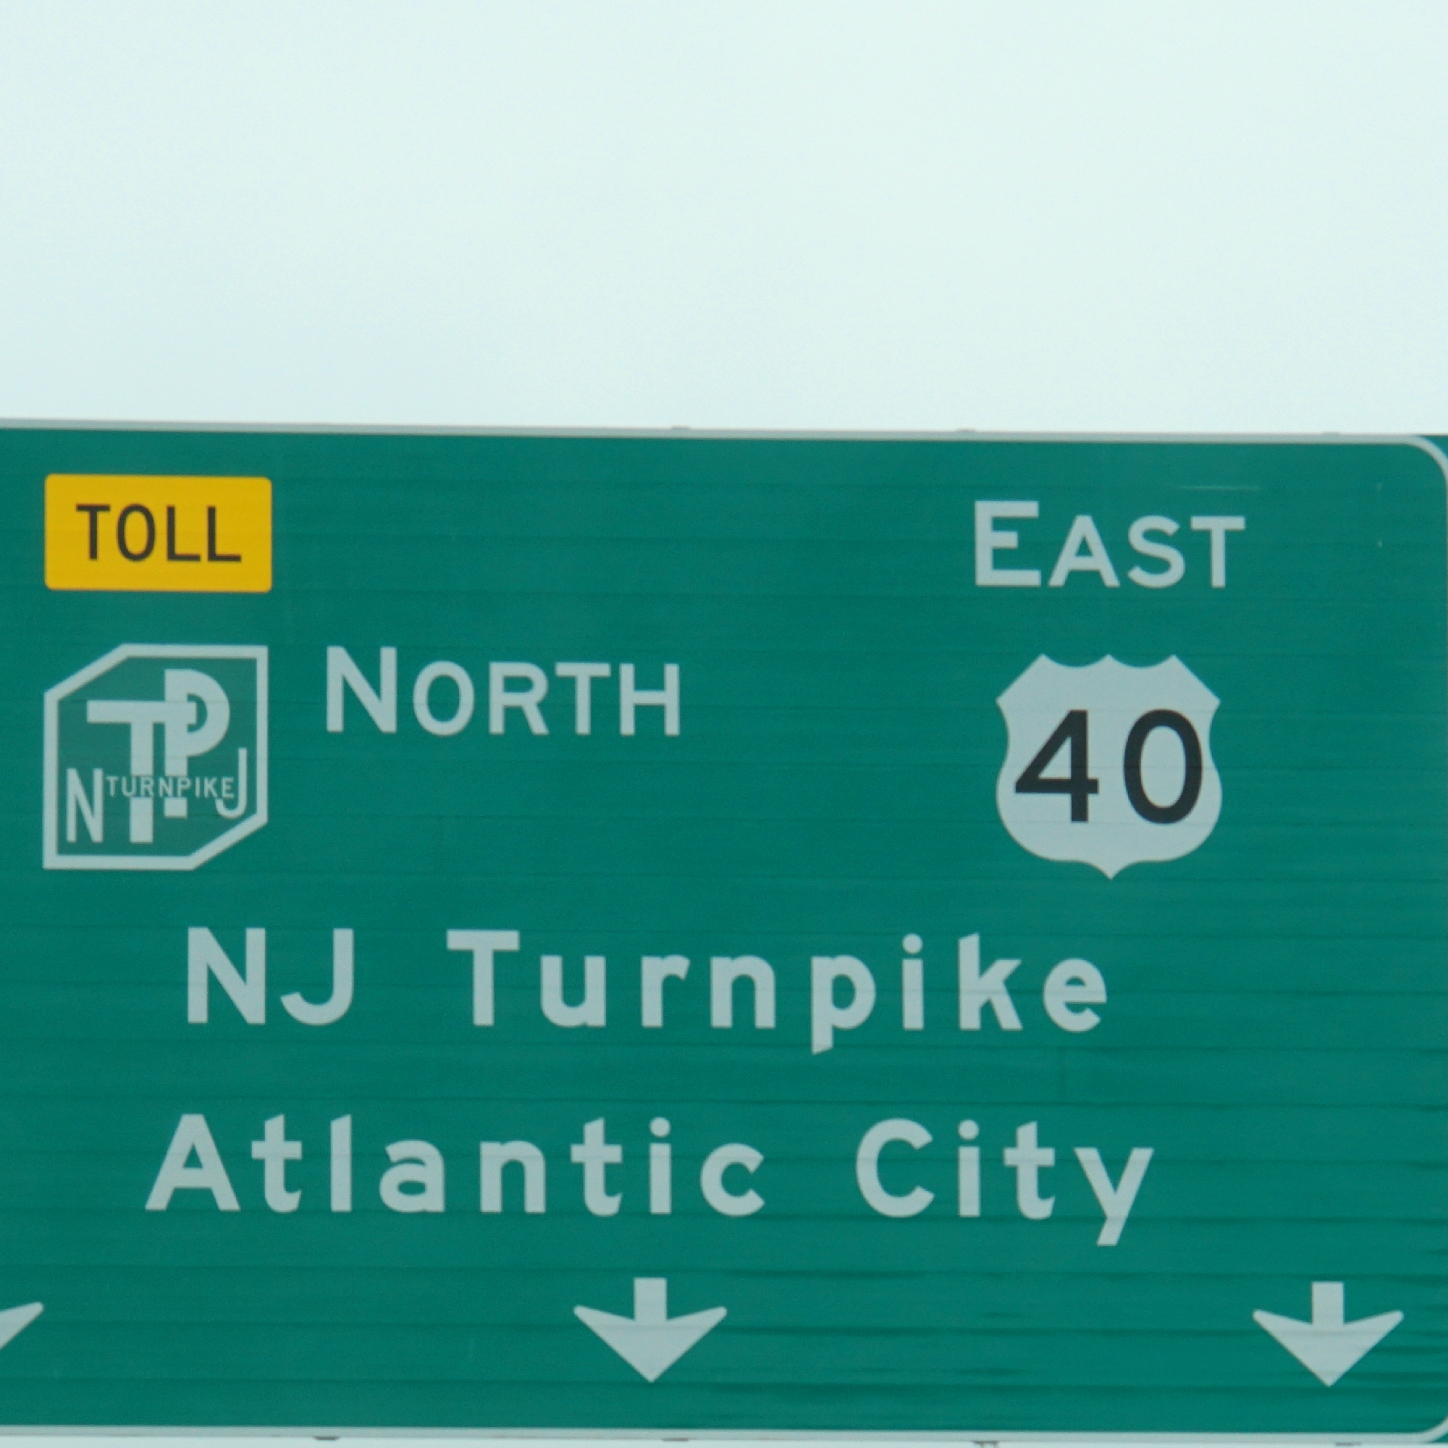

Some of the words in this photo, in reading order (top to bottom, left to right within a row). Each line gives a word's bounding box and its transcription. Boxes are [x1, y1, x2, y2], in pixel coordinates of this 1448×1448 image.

[75, 503, 242, 563] TOLL
[974, 500, 1246, 588] EAST
[326, 646, 681, 736] NORTH
[105, 775, 236, 799] TURNPIKE
[1014, 709, 1203, 825] 40
[187, 927, 355, 1027] NJ
[446, 929, 1108, 1055] Turnpike
[145, 1113, 766, 1217] Atlantic
[855, 1118, 1153, 1247] City
